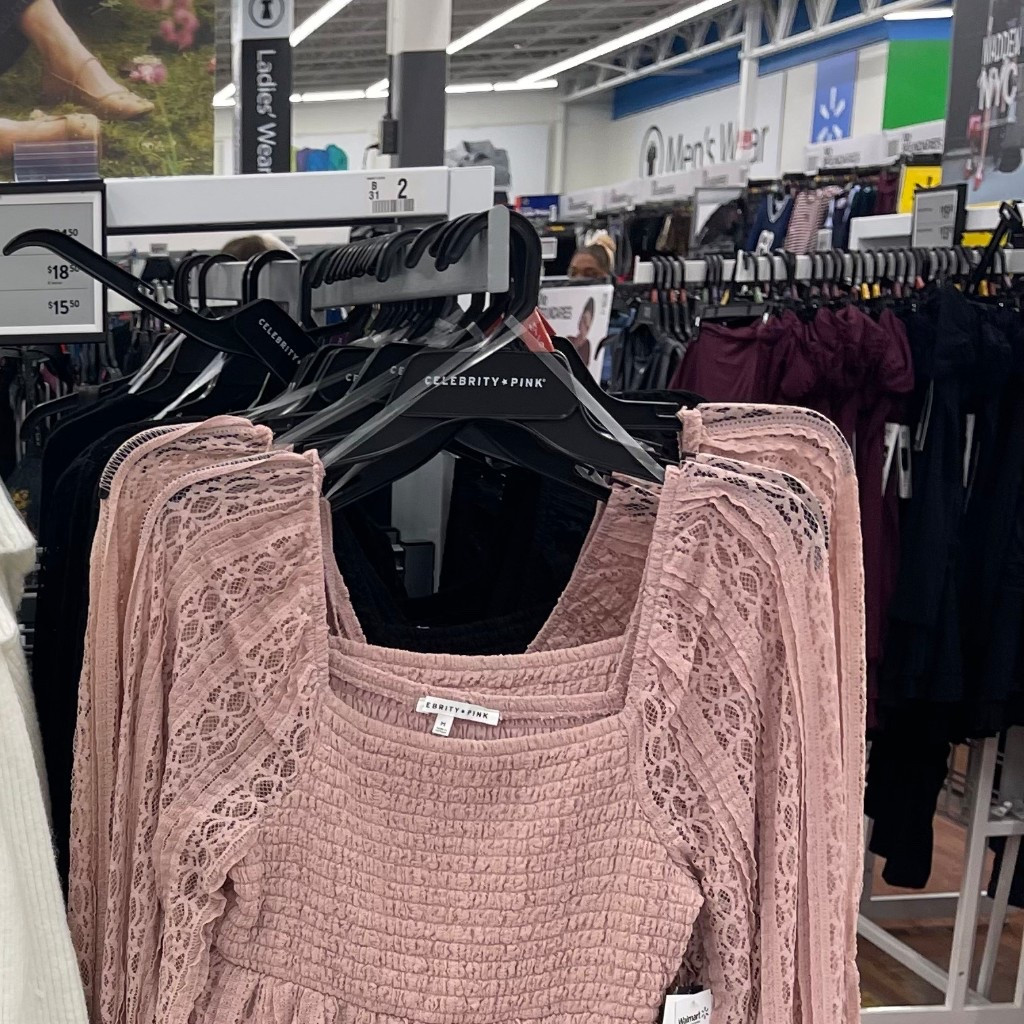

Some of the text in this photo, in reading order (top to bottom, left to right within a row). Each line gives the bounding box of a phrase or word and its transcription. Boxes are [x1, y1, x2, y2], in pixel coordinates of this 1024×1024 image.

[256, 49, 277, 118] Ladies'
[665, 132, 716, 173] Men's
[368, 191, 379, 200] 31
[397, 178, 408, 199] 2
[258, 318, 299, 361] CELEBRITY
[424, 376, 499, 387] CELEBRITY
[467, 709, 489, 719] PINK
